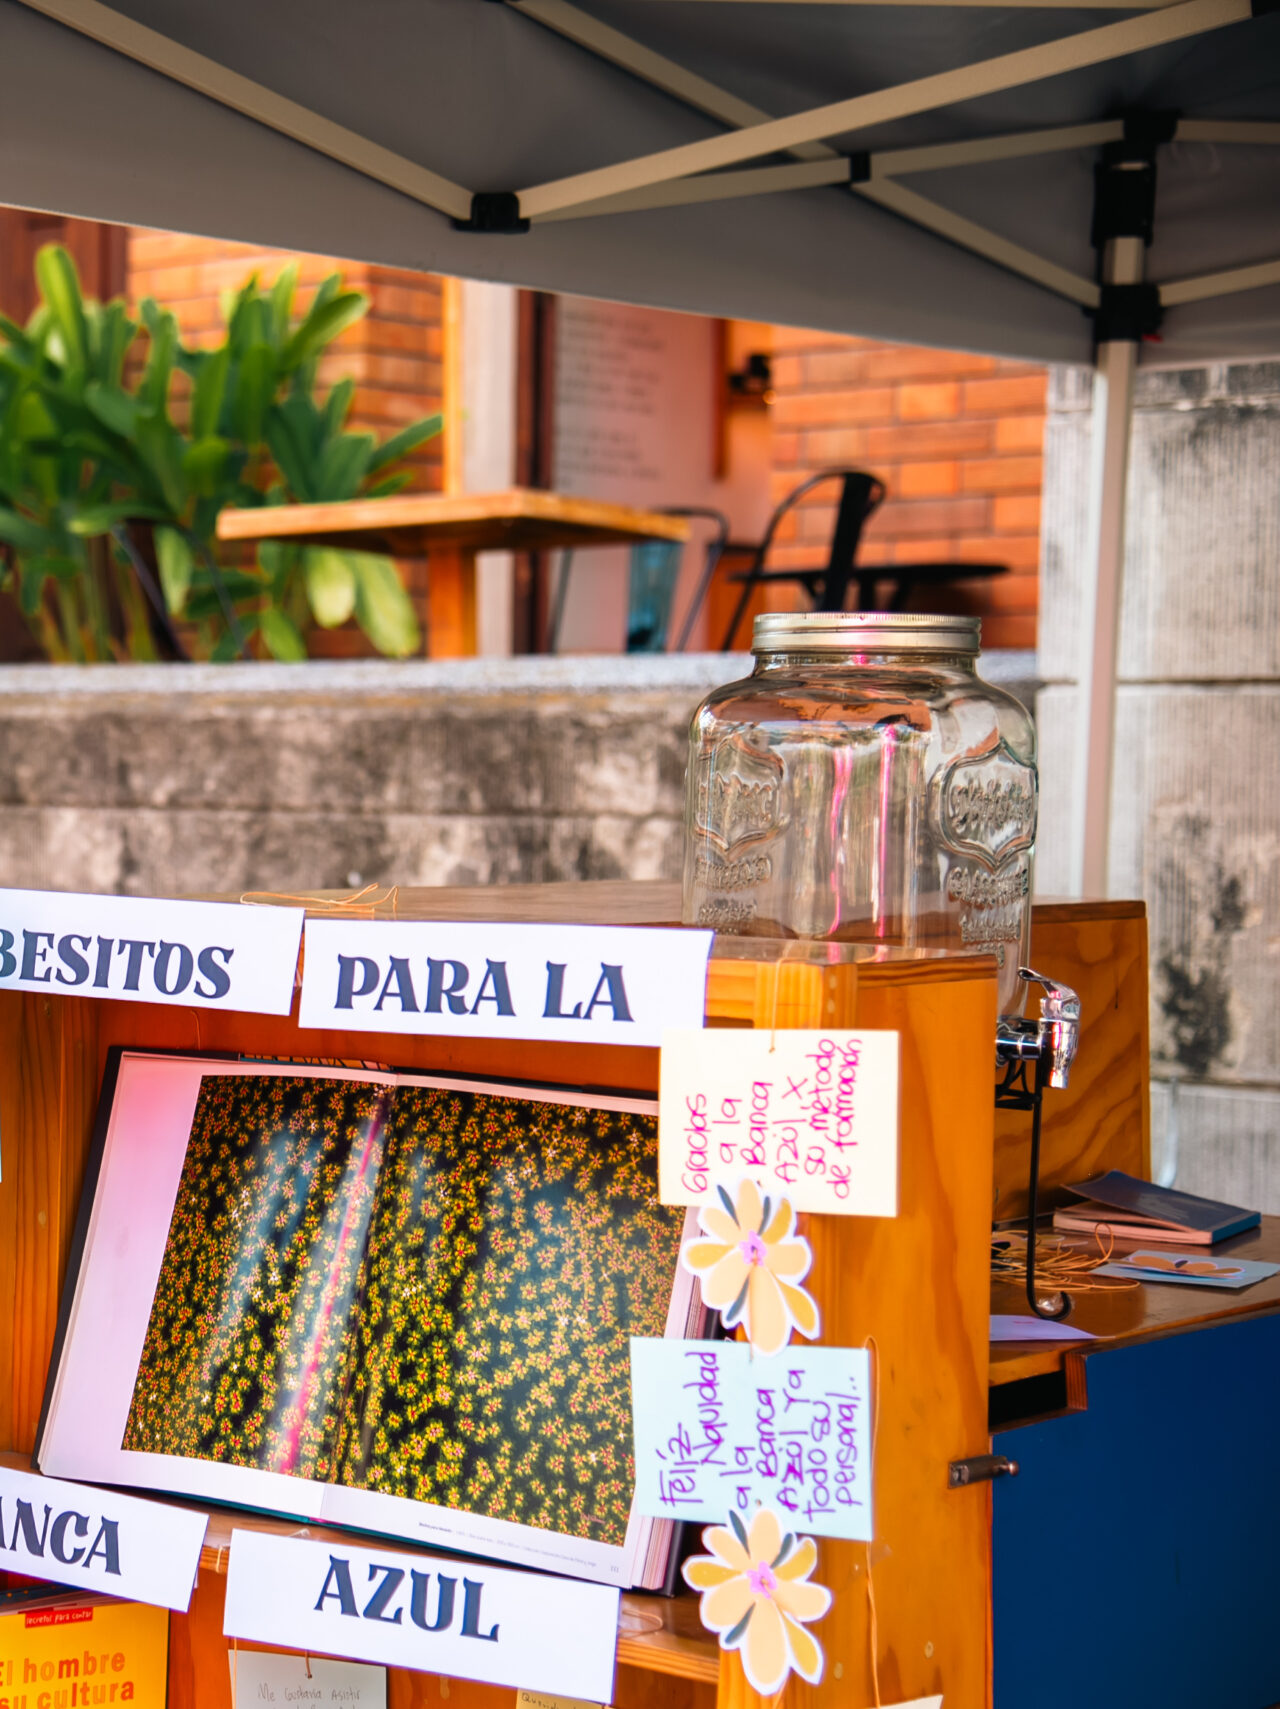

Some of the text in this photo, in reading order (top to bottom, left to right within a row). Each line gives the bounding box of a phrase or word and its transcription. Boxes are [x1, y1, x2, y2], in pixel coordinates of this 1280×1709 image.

[334, 953, 634, 1022] PARA LA
[682, 1094, 710, 1193] Gracias
[712, 1098, 742, 1164] a la
[740, 1081, 773, 1166] Banca
[827, 1165, 851, 1199] de
[683, 1351, 728, 1466] Navidad
[756, 1388, 776, 1477] Banca
[720, 1446, 756, 1509] a la
[802, 1449, 836, 1522] todo
[55, 1611, 70, 1624] para
[314, 1554, 500, 1642] AZUL
[23, 1650, 126, 1684] hombre
[37, 1681, 135, 1709] cultura
